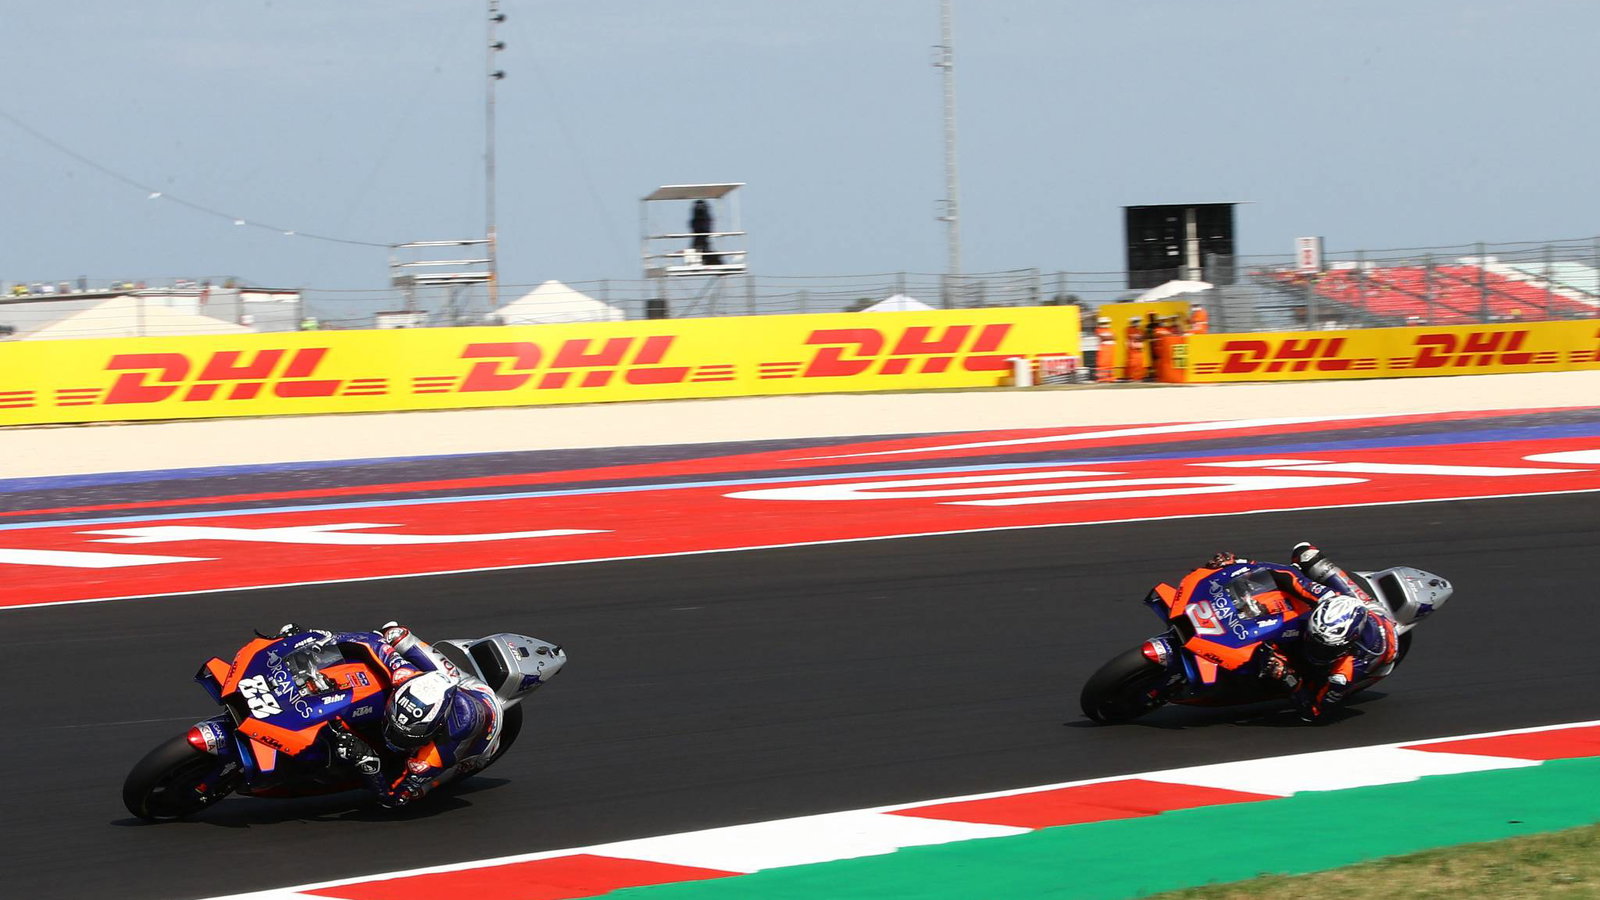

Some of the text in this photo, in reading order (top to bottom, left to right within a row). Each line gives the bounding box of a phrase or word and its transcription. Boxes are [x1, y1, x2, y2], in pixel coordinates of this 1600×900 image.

[459, 336, 691, 393] DHL
[803, 323, 1026, 378] DHL
[1221, 338, 1352, 374] DHL
[1413, 330, 1533, 368] DHL
[103, 347, 342, 405] DHL
[1185, 600, 1226, 635] 27
[1209, 582, 1249, 640] ORGANICS
[238, 674, 283, 719] 88
[267, 656, 313, 719] ORGANICS
[398, 696, 424, 719] MEO
